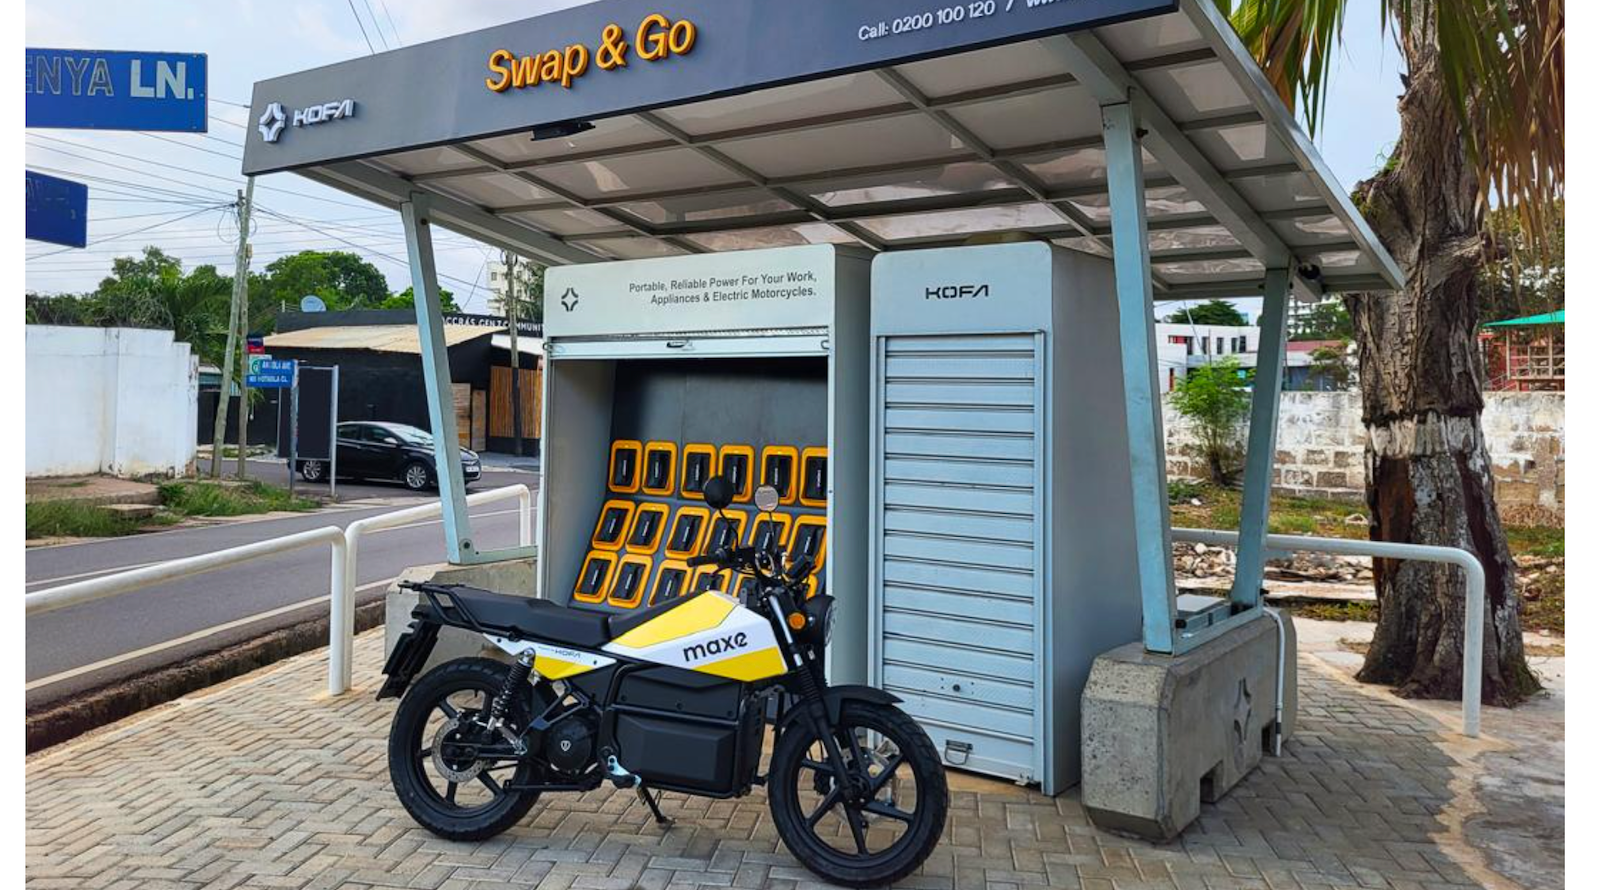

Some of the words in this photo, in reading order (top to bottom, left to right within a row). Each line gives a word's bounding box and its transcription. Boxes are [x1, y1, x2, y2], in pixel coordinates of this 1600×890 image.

[858, 22, 889, 41] Call:
[892, 12, 933, 34] 0200
[936, 5, 965, 25] 100
[968, 0, 996, 18] 120
[485, 49, 590, 93] Swap
[595, 23, 627, 70] &
[635, 13, 697, 61] Go
[130, 59, 194, 99] LN.
[292, 99, 355, 126] KOFA
[629, 281, 668, 293] Portable,
[670, 279, 707, 290] Reliable
[709, 277, 740, 288] Power
[742, 275, 759, 286] For
[761, 273, 785, 285] Your
[787, 270, 817, 283] Work,
[925, 284, 989, 300] KOFA
[650, 293, 700, 306] Appliances
[703, 291, 710, 302] &
[713, 290, 749, 301] Electric
[751, 286, 817, 300] Motorcycles.
[683, 632, 748, 662] maxe
